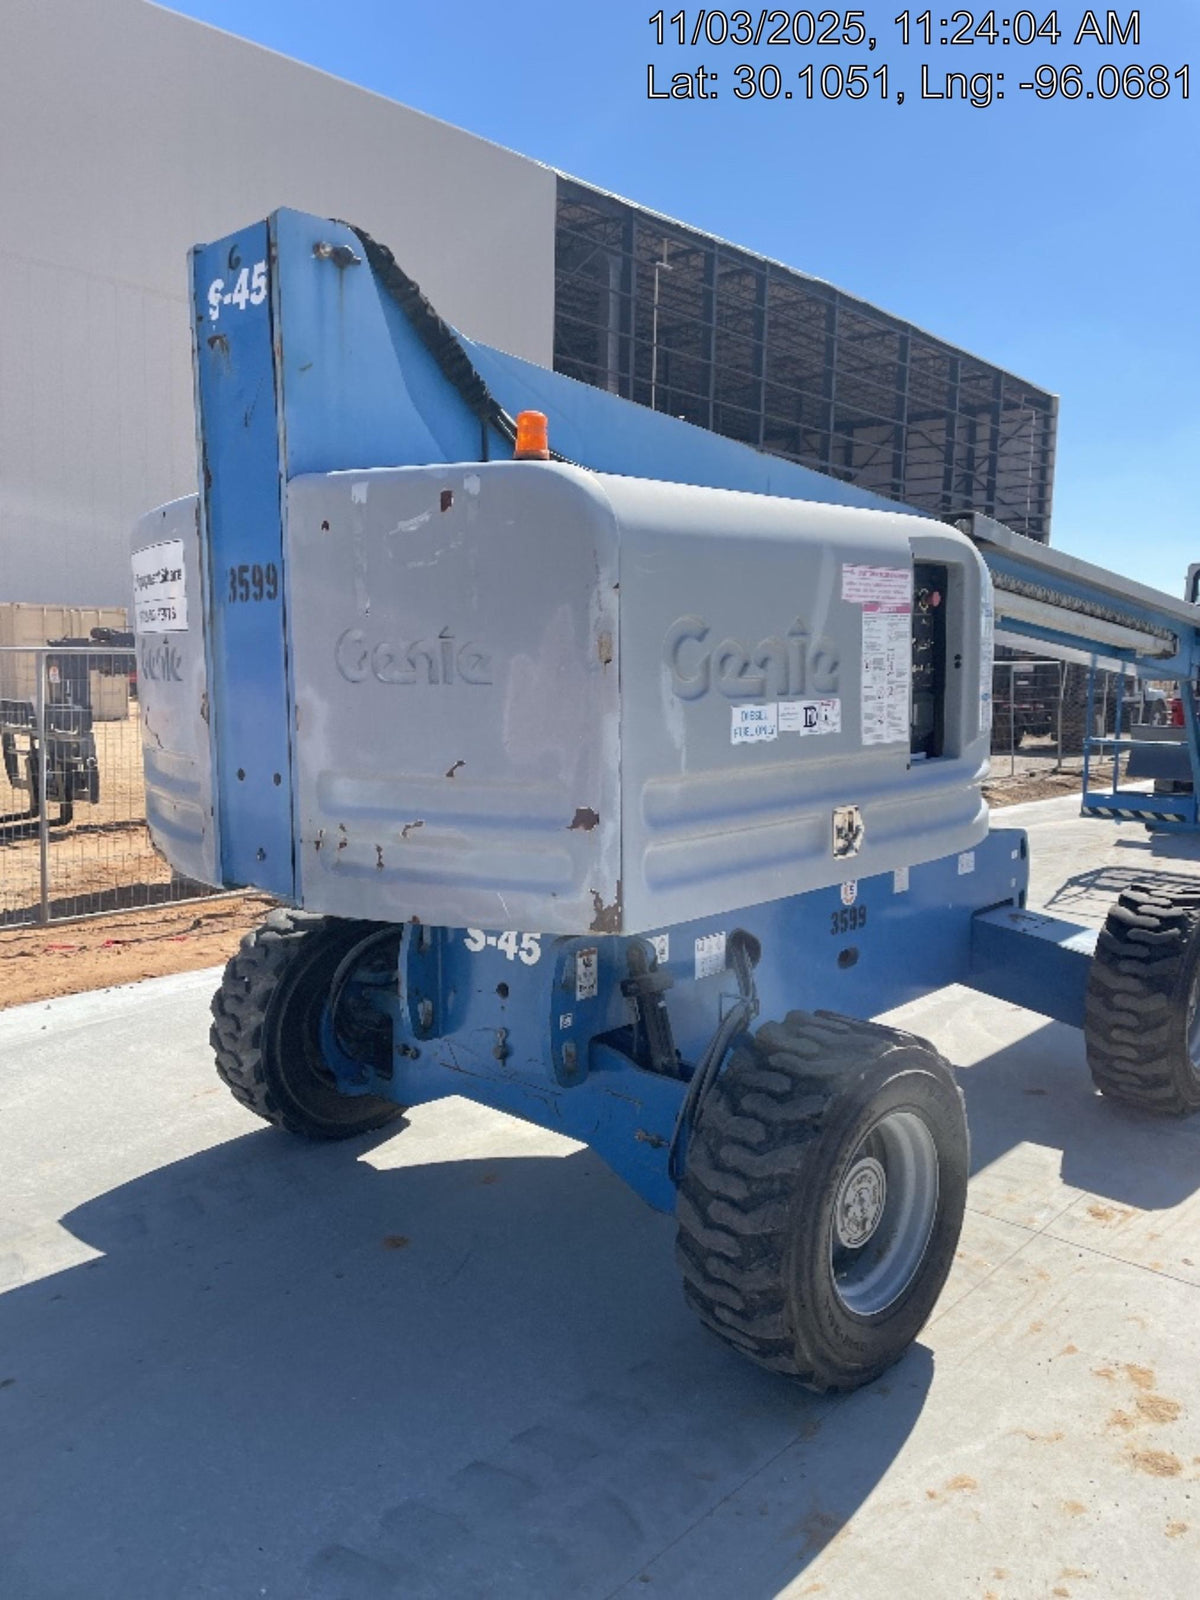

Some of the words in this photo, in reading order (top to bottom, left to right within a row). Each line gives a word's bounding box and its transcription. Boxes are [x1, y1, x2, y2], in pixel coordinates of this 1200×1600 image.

[208, 259, 268, 321] S-45
[335, 625, 493, 685] Genie
[662, 613, 840, 701] Genie
[463, 927, 541, 966] S-45
[830, 905, 867, 936] 3599
